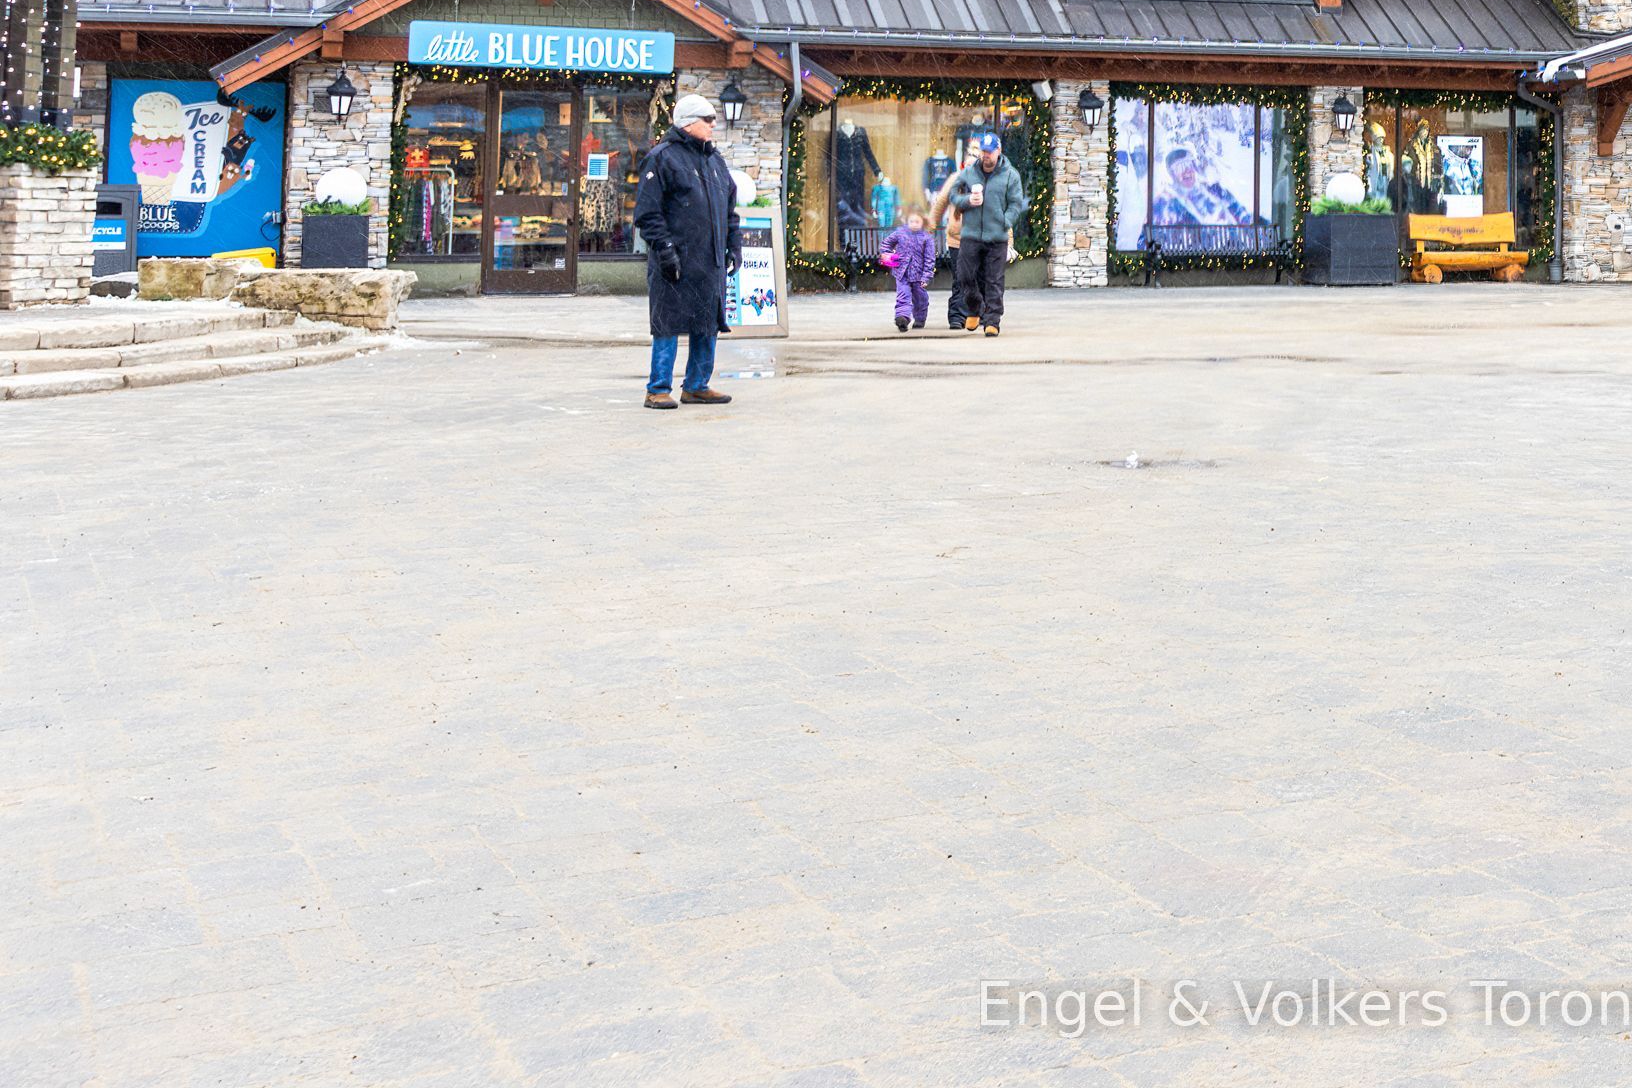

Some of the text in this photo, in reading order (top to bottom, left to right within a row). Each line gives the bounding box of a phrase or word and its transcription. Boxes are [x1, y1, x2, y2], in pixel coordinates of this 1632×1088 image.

[423, 30, 655, 70] little BLUE HOUSE
[185, 108, 224, 130] Ice
[190, 130, 206, 194] CREAM
[139, 207, 176, 221] BLUE
